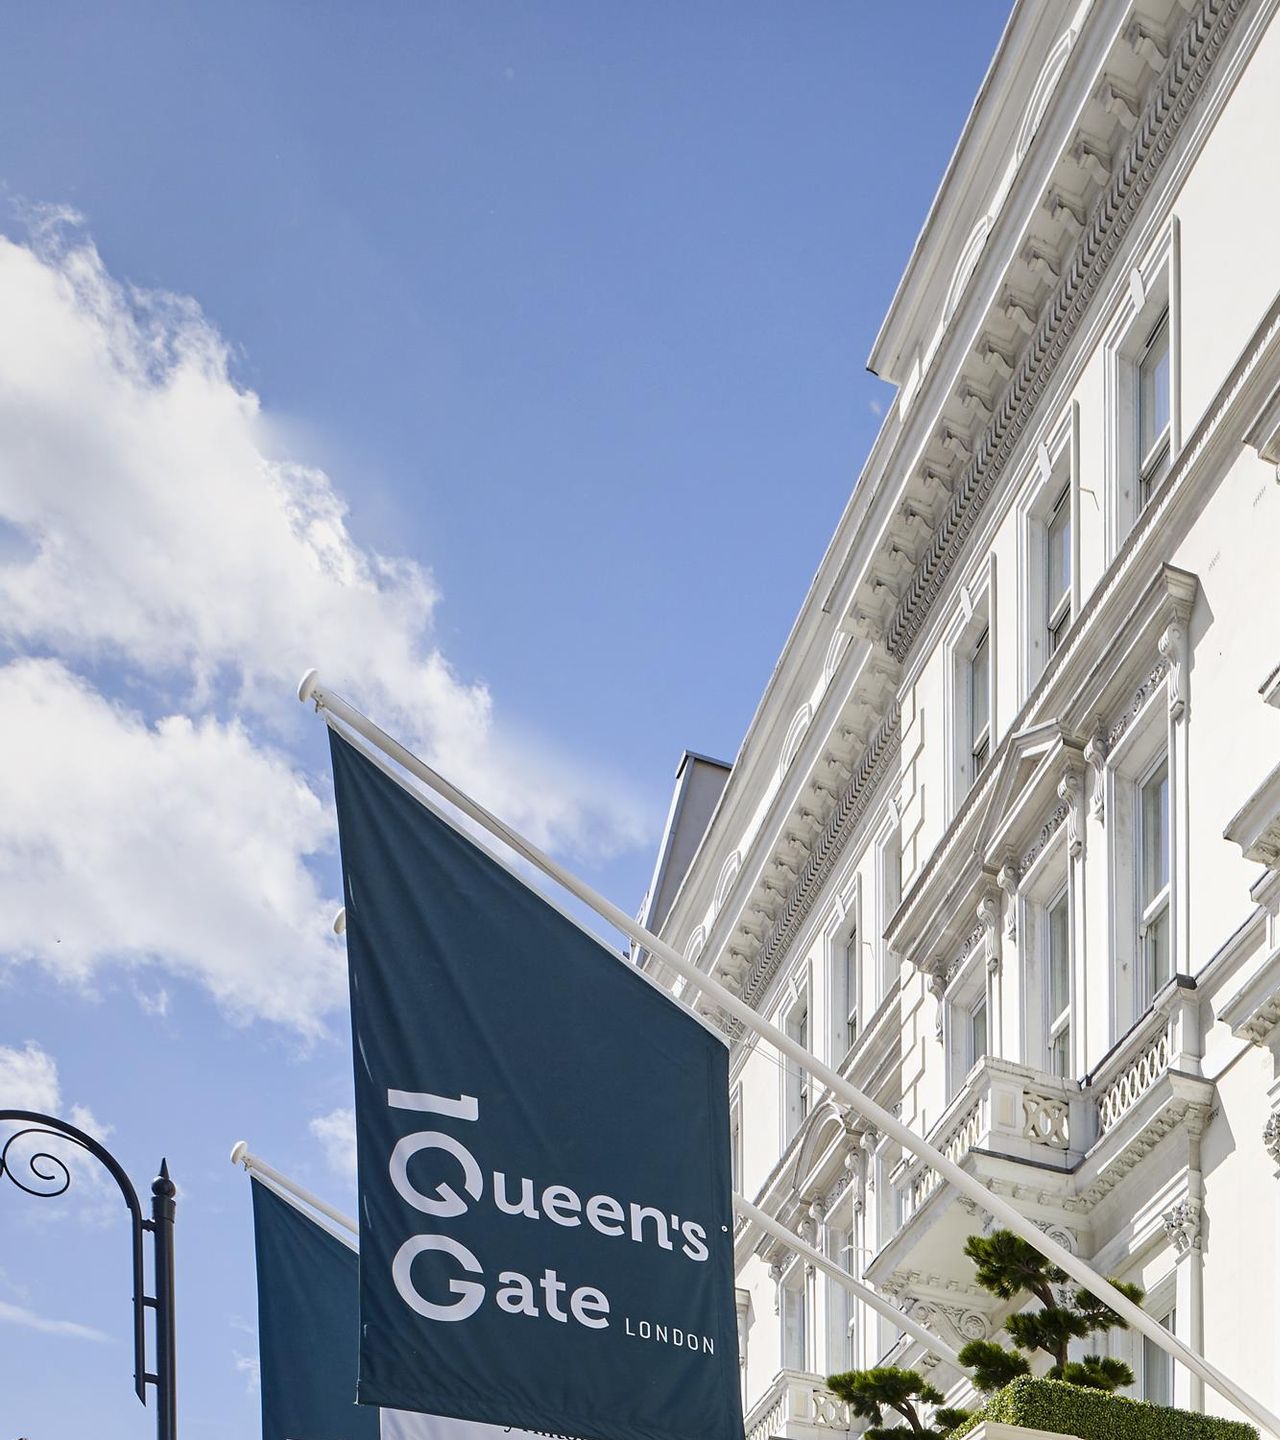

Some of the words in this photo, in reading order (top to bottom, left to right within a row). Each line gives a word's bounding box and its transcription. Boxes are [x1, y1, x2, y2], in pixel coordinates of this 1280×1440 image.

[389, 1131, 709, 1262] Queen's
[392, 1234, 610, 1329] Gate
[626, 1318, 715, 1355] LONDON
